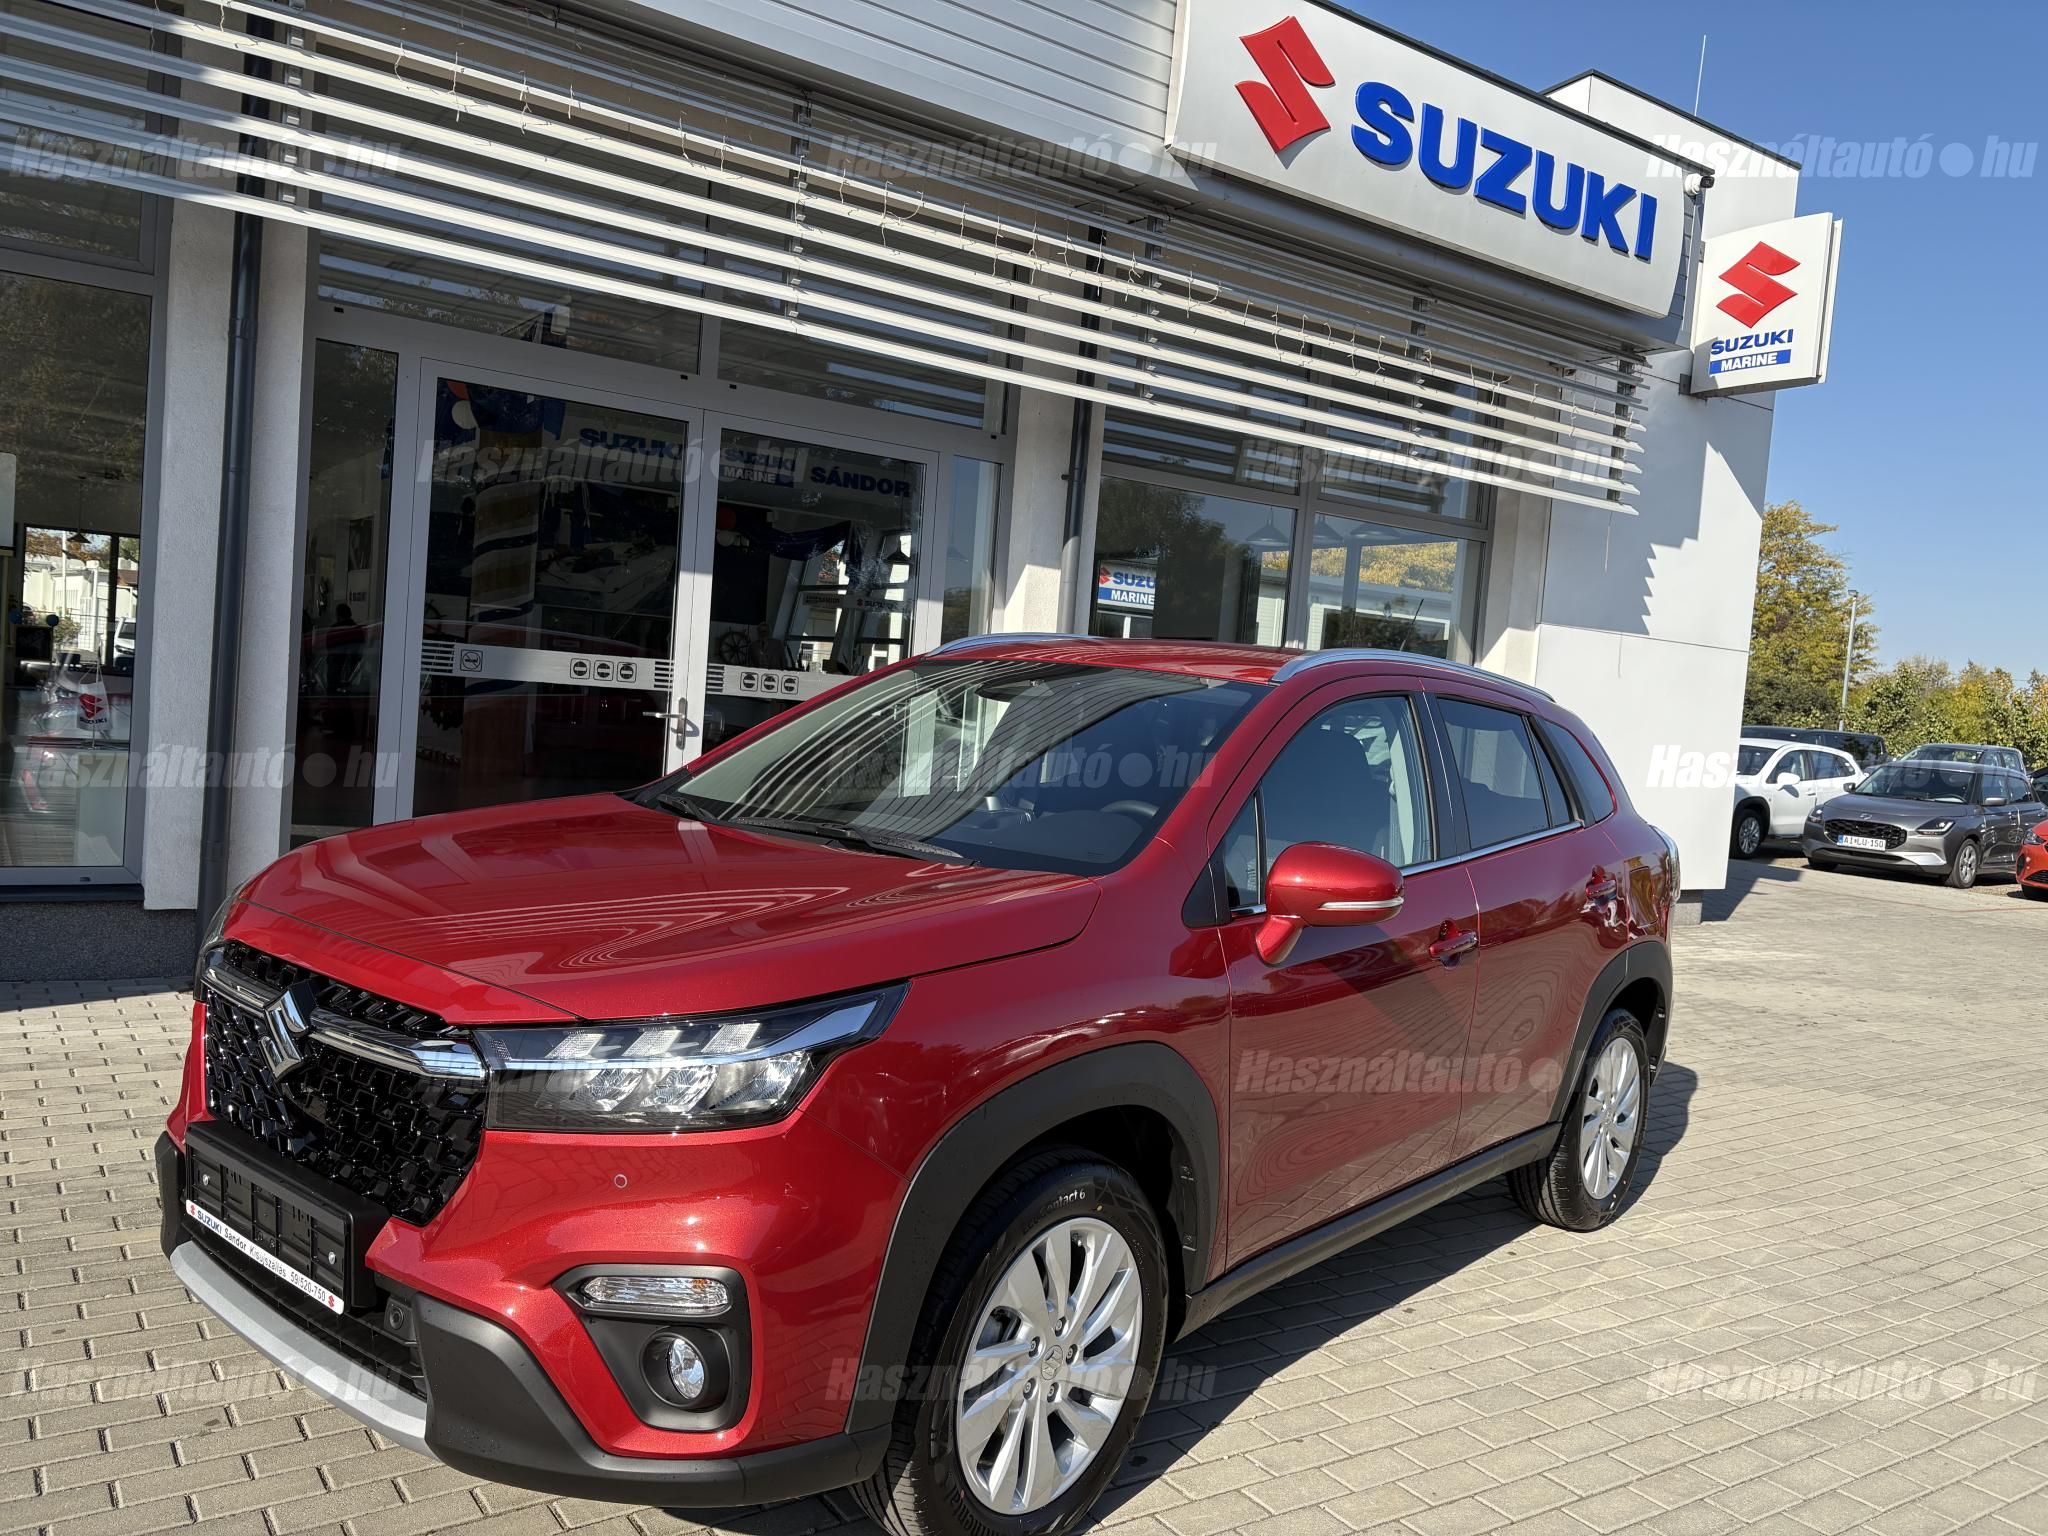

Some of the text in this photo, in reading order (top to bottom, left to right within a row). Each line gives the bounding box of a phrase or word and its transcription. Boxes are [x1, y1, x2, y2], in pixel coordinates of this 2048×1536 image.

[1351, 81, 1657, 262] SUZUKI
[1711, 329, 1794, 355] SUZUKI
[1720, 352, 1778, 372] MARINE
[724, 447, 795, 472] SUZUKI
[723, 465, 776, 484] MARINE
[810, 466, 910, 498] SÁNDOR
[1112, 571, 1156, 589] SUZU
[1110, 589, 1156, 605] MARINE
[197, 1210, 222, 1234] SUZUKI
